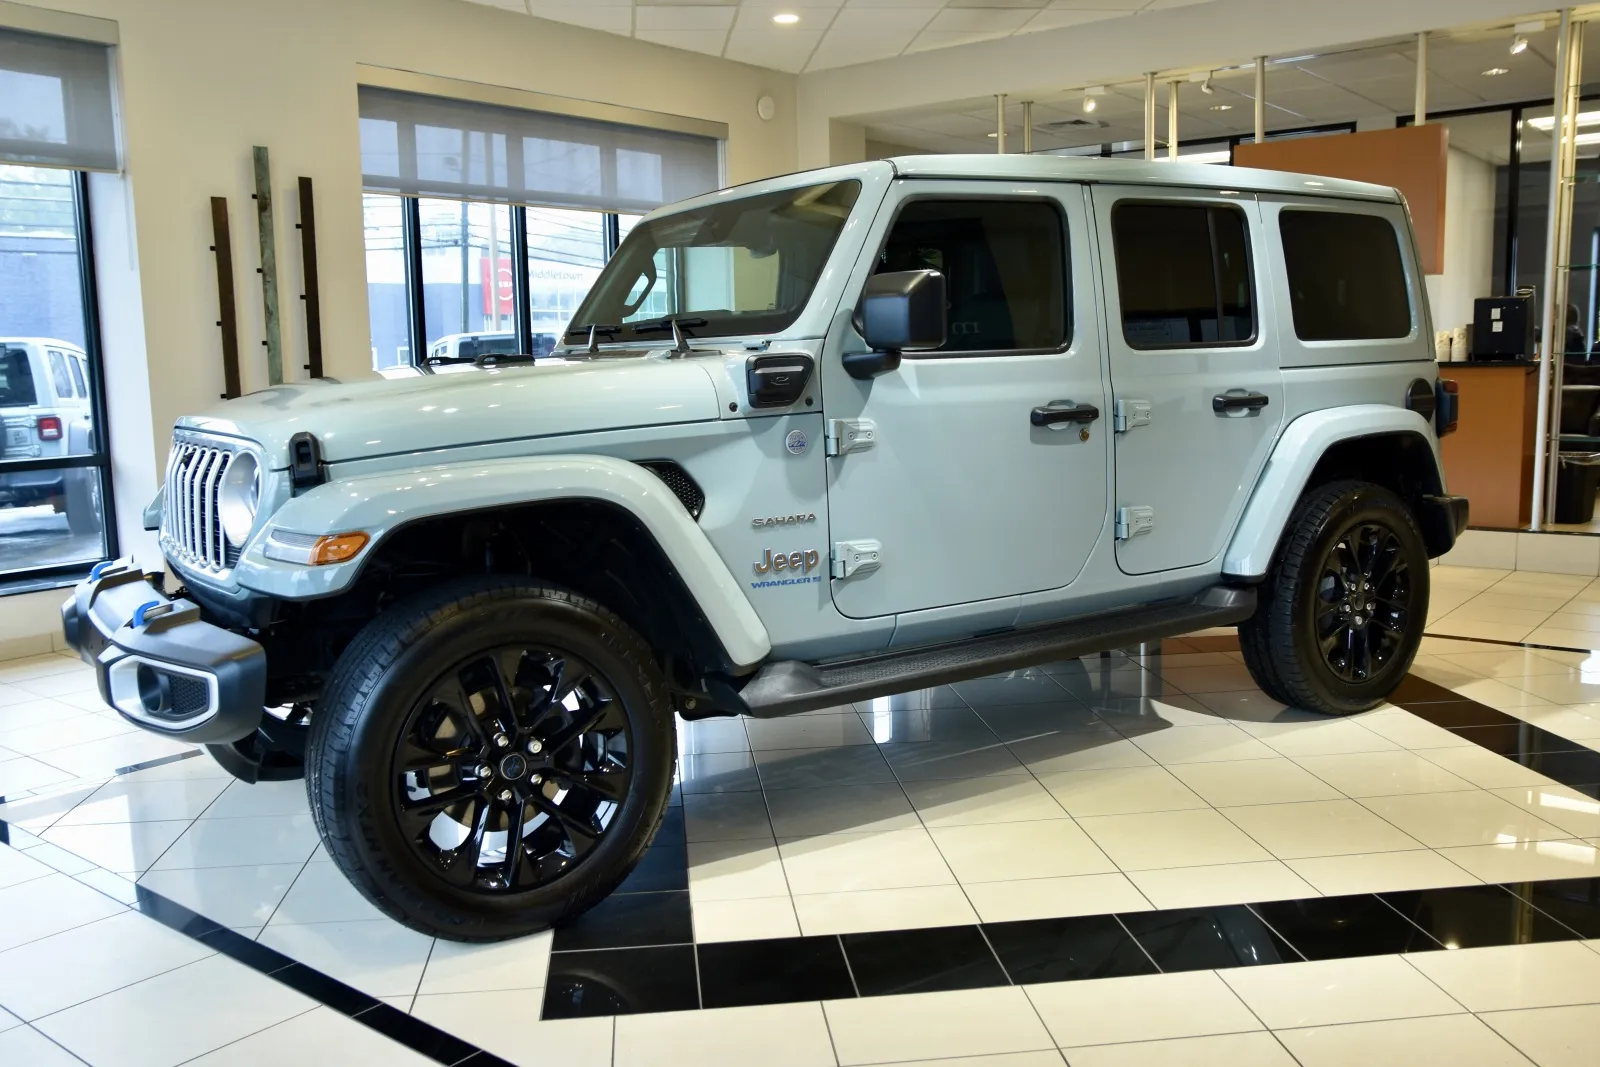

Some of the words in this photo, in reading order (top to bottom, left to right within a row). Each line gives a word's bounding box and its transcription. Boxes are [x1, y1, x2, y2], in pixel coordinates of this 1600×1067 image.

[752, 513, 816, 527] SAHARA
[753, 548, 819, 573] Jeep
[751, 576, 811, 589] WRANGLER
